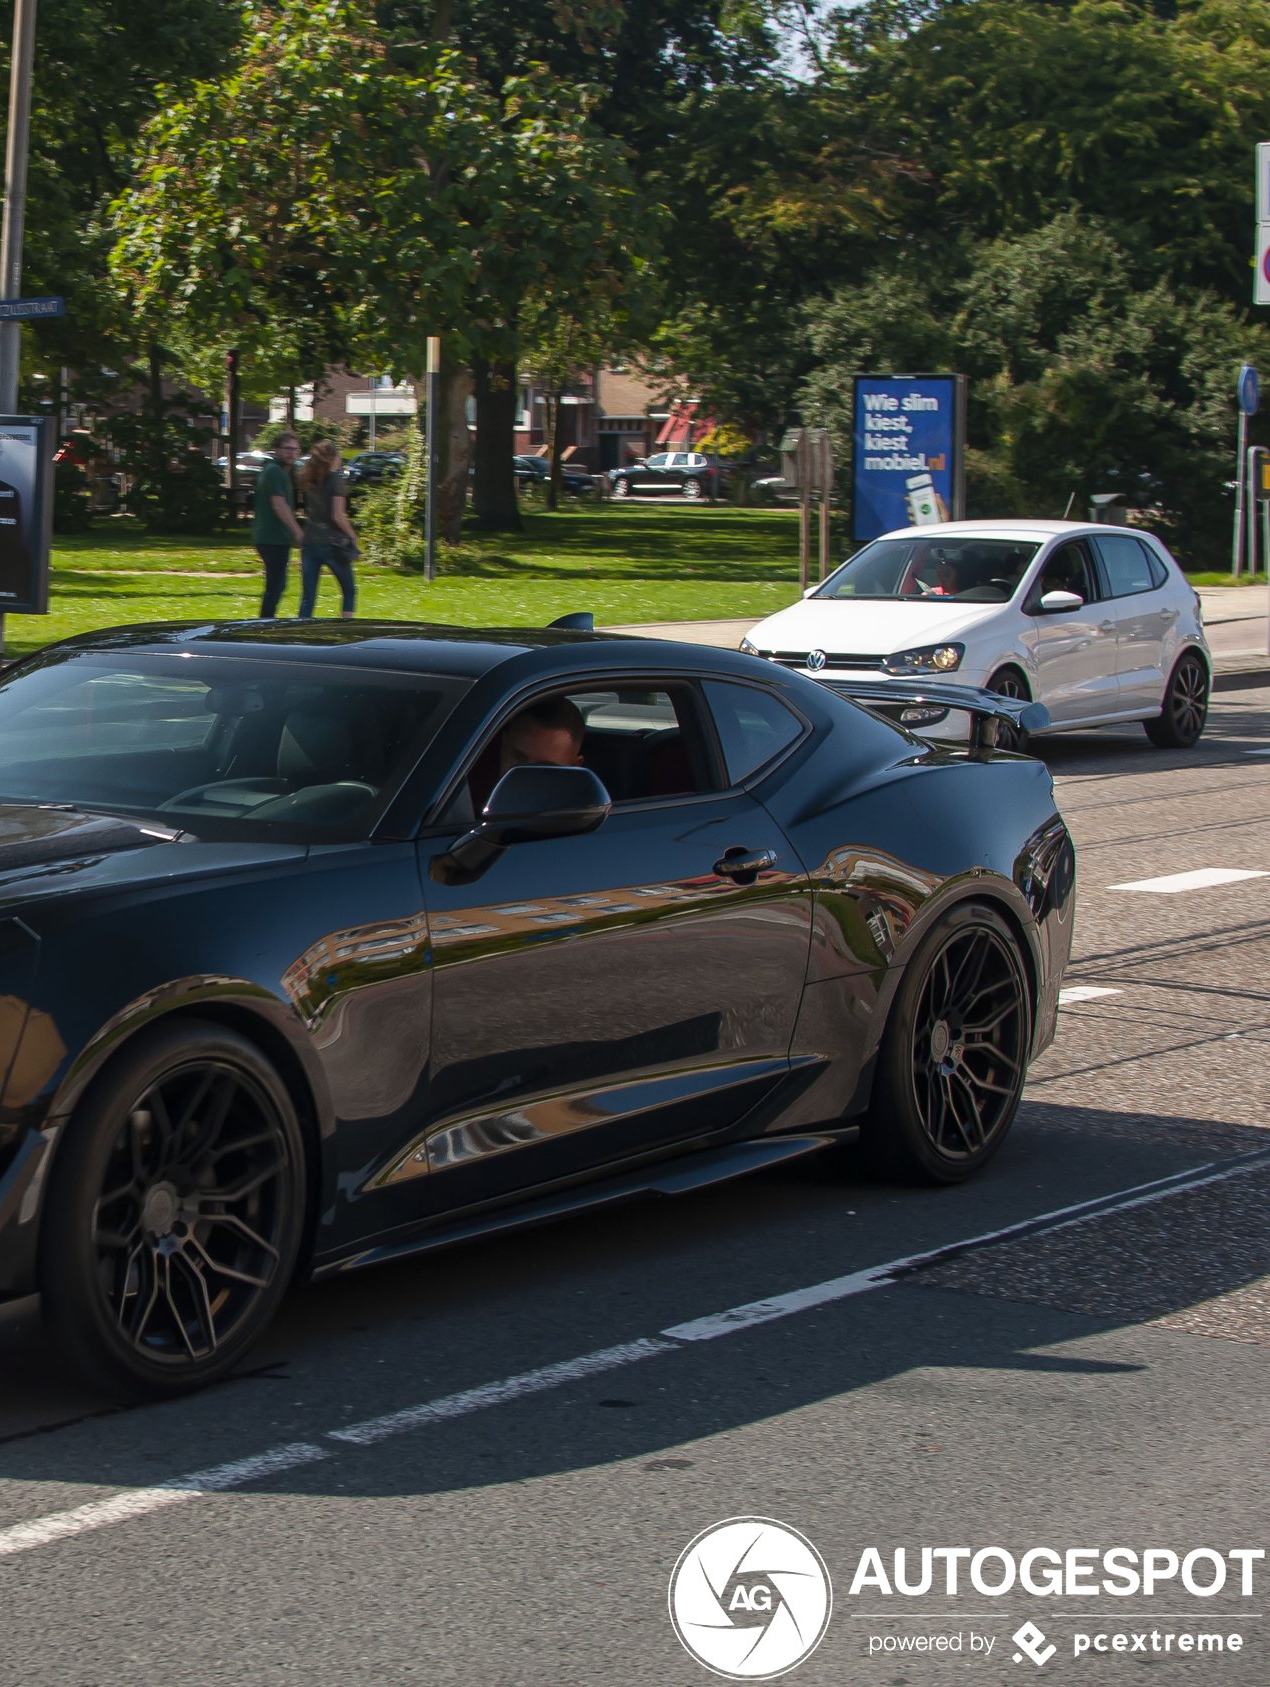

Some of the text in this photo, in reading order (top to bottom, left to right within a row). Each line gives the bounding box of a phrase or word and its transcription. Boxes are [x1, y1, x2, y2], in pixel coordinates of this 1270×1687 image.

[863, 393, 939, 411] Wie slim
[864, 433, 909, 450] kiest
[864, 453, 946, 471] mobiel.nl
